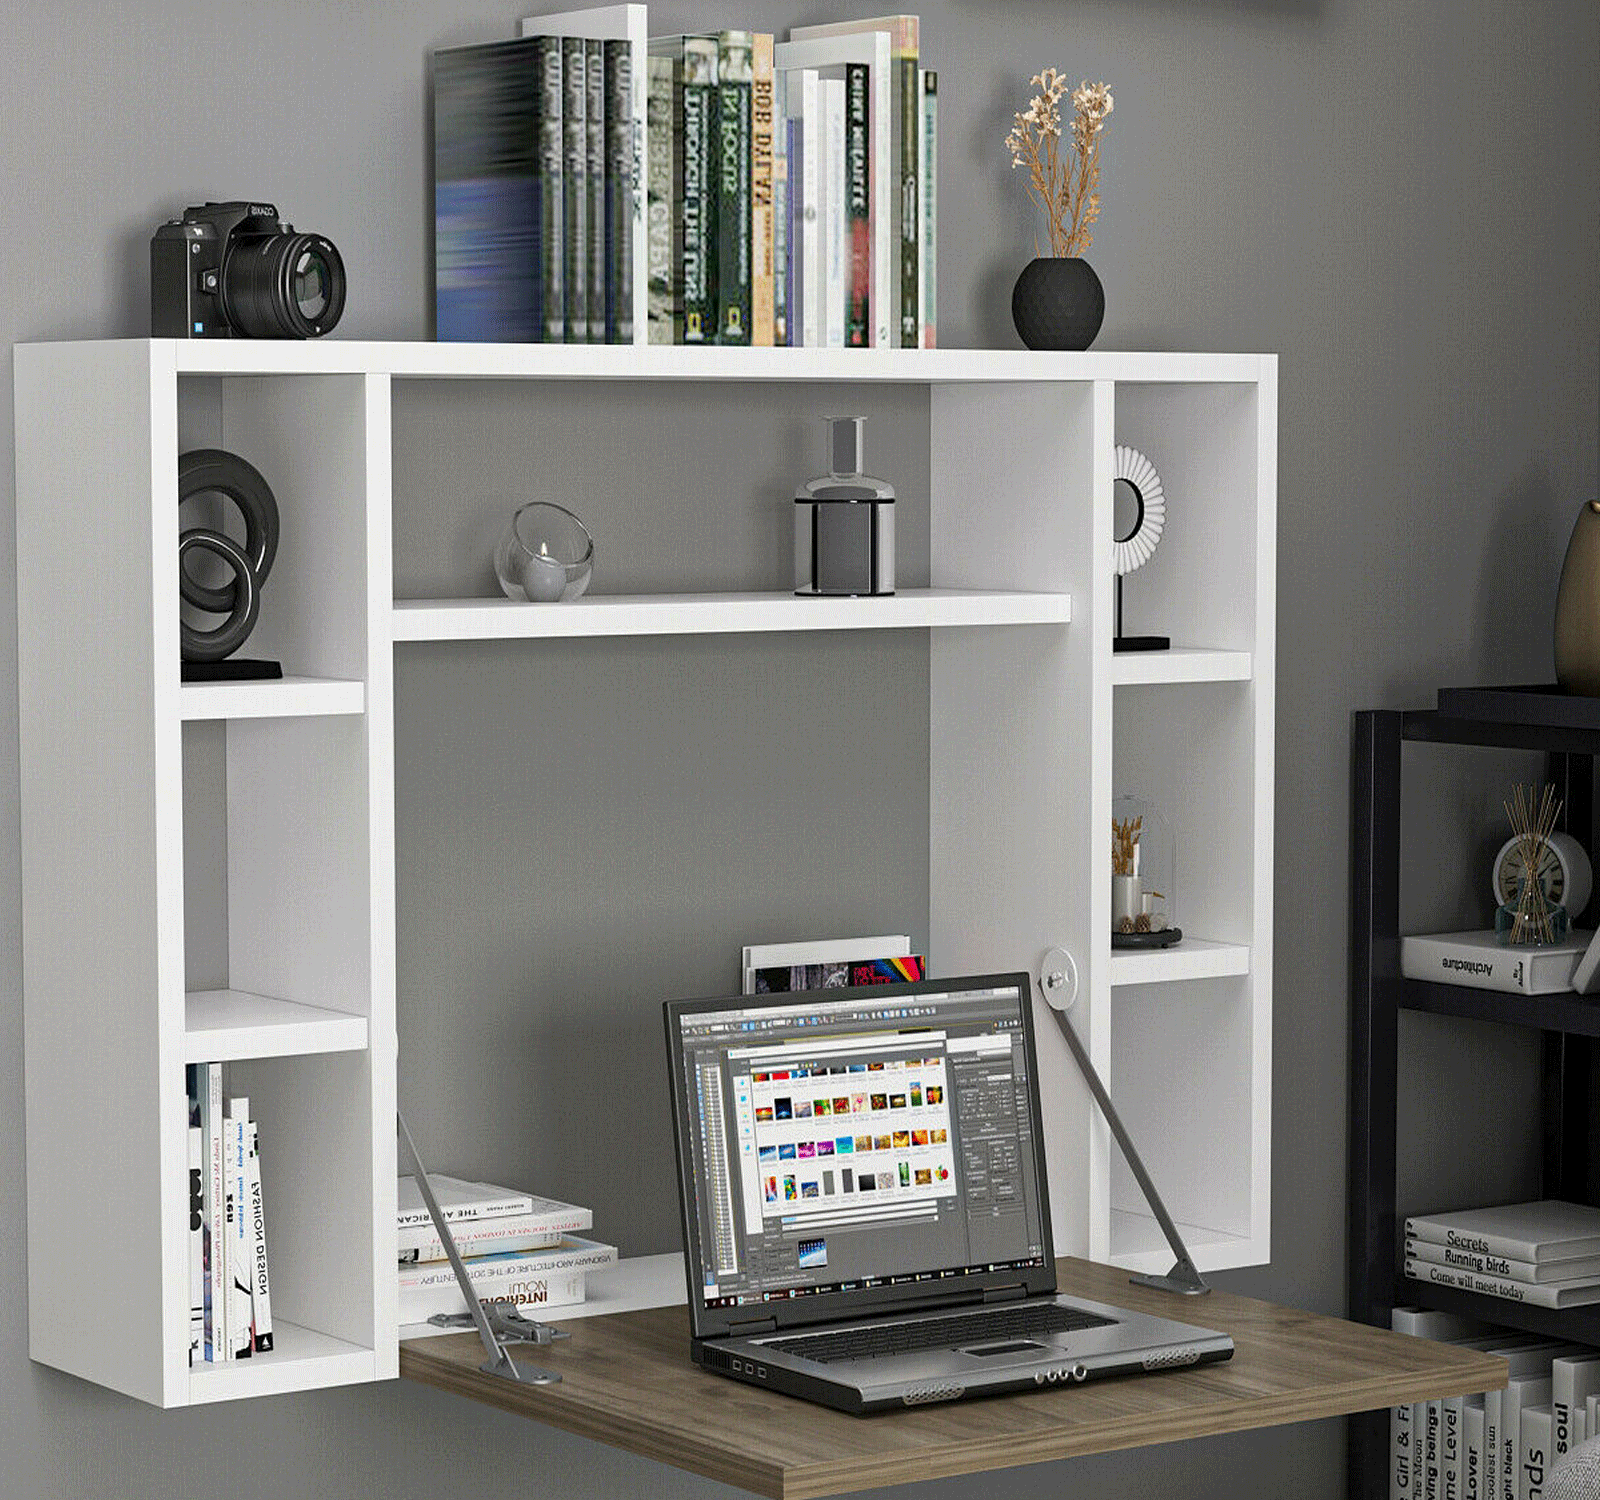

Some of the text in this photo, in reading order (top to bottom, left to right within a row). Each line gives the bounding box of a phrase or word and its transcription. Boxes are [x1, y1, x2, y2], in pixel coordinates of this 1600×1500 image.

[1442, 958, 1493, 977] Architecture
[397, 1209, 478, 1223] THE ARICAN
[1446, 1230, 1489, 1253] Secrets
[1444, 1249, 1511, 1275] Running birds
[420, 1274, 457, 1286] ENTURY
[1429, 1267, 1525, 1301] Come will meet today
[1397, 1431, 1409, 1447] &
[1426, 1406, 1438, 1462] beings
[1444, 1408, 1457, 1461] Level
[1487, 1425, 1496, 1449] sun
[1554, 1402, 1569, 1455] soul
[1396, 1454, 1409, 1488] Girl
[1413, 1438, 1422, 1478] Moon
[1466, 1446, 1478, 1500] Lover
[1503, 1438, 1513, 1475] black
